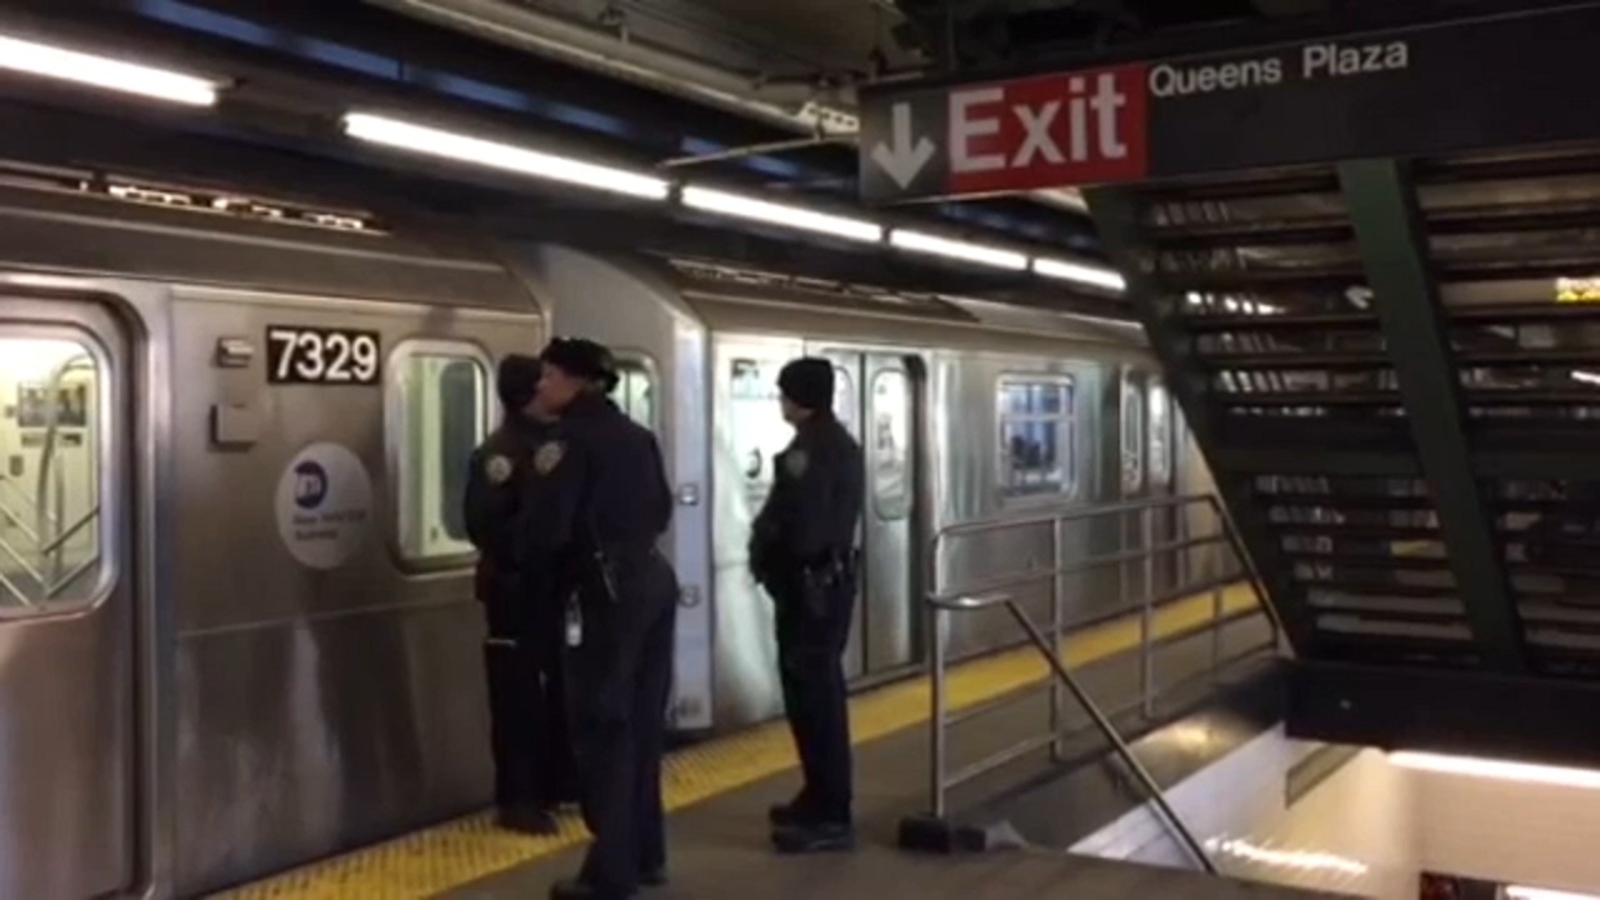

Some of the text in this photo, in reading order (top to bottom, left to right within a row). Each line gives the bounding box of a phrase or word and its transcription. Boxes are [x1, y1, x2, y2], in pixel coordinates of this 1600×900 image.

[1149, 41, 1408, 97] Queens Plaza
[950, 73, 1127, 173] Exit
[270, 330, 377, 380] 7329
